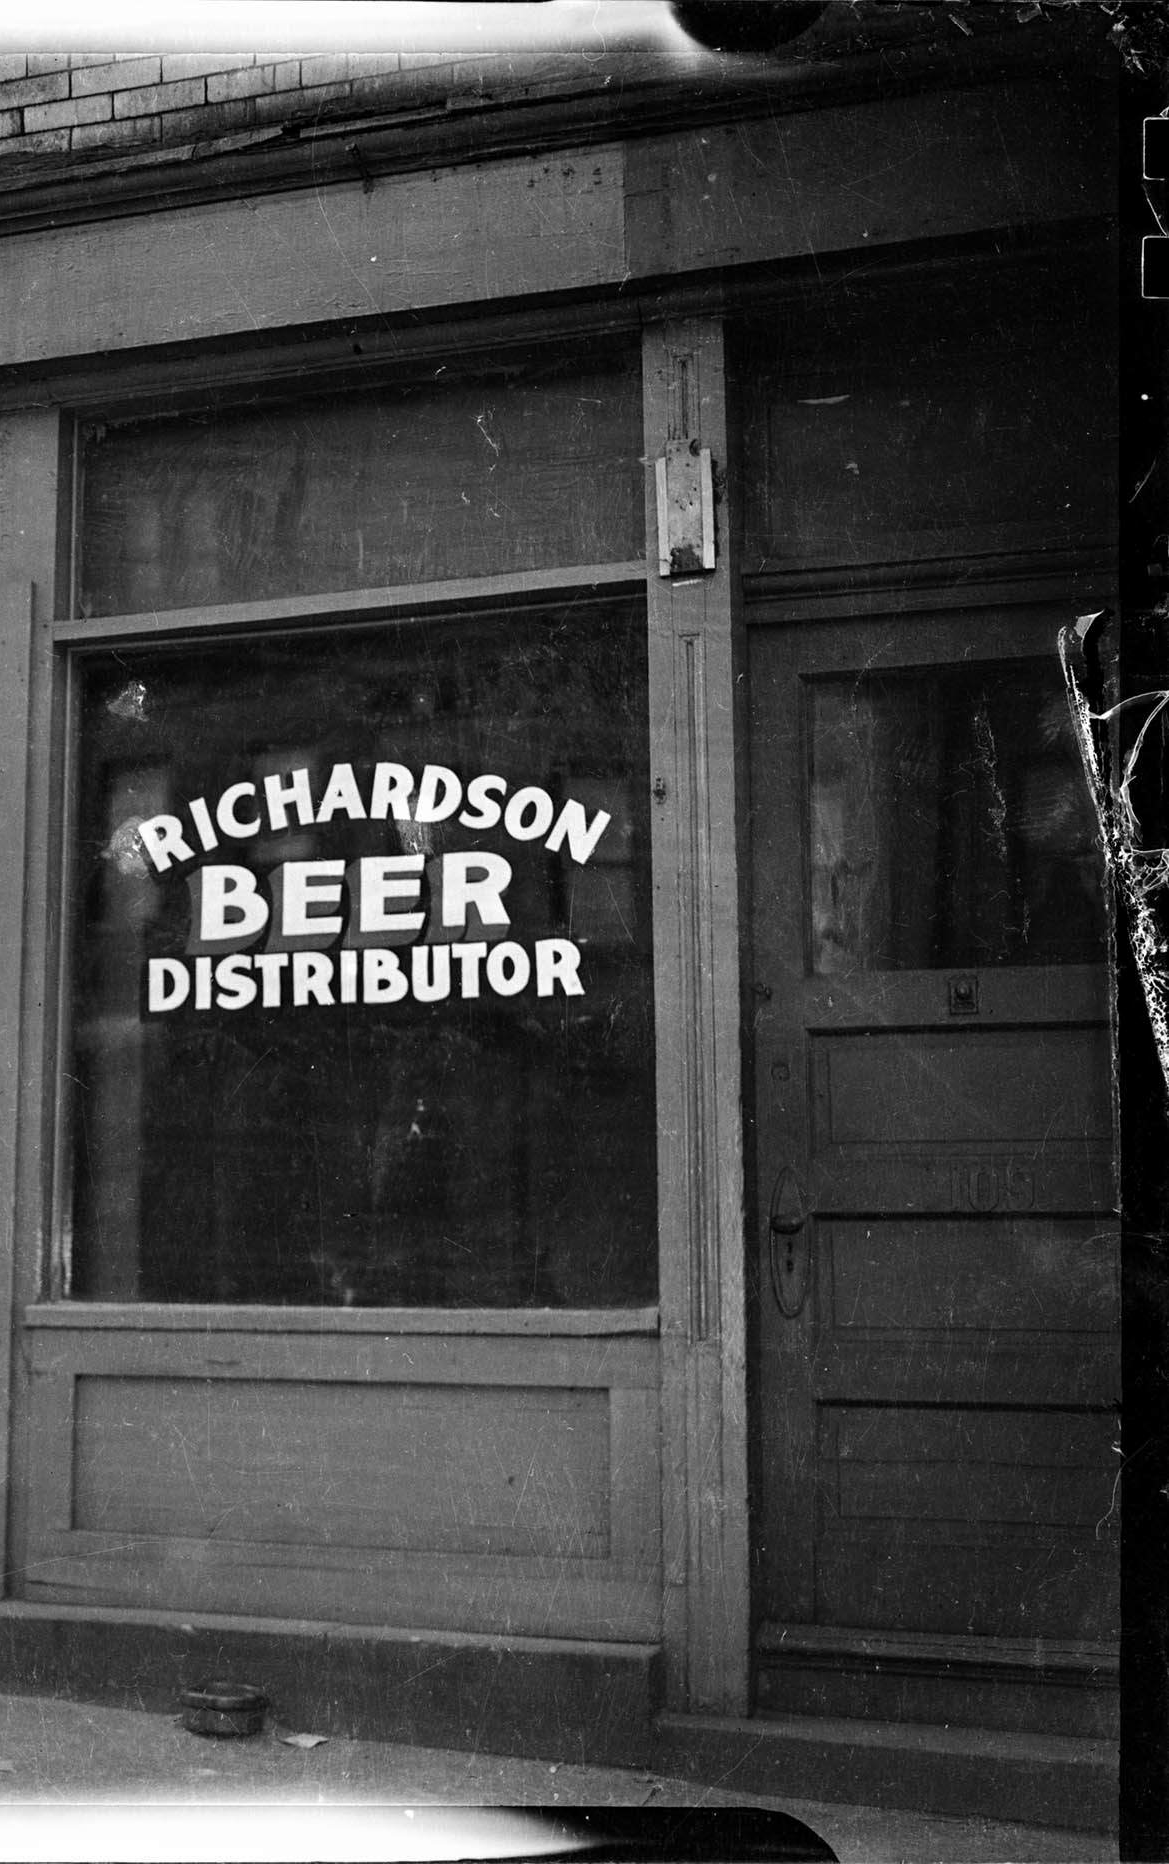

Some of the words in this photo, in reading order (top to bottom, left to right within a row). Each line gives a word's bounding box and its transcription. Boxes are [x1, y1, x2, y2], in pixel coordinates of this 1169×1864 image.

[137, 763, 611, 872] RICHARDSON
[200, 852, 512, 941] BEER
[148, 939, 585, 1013] DISTRIBUTOR
